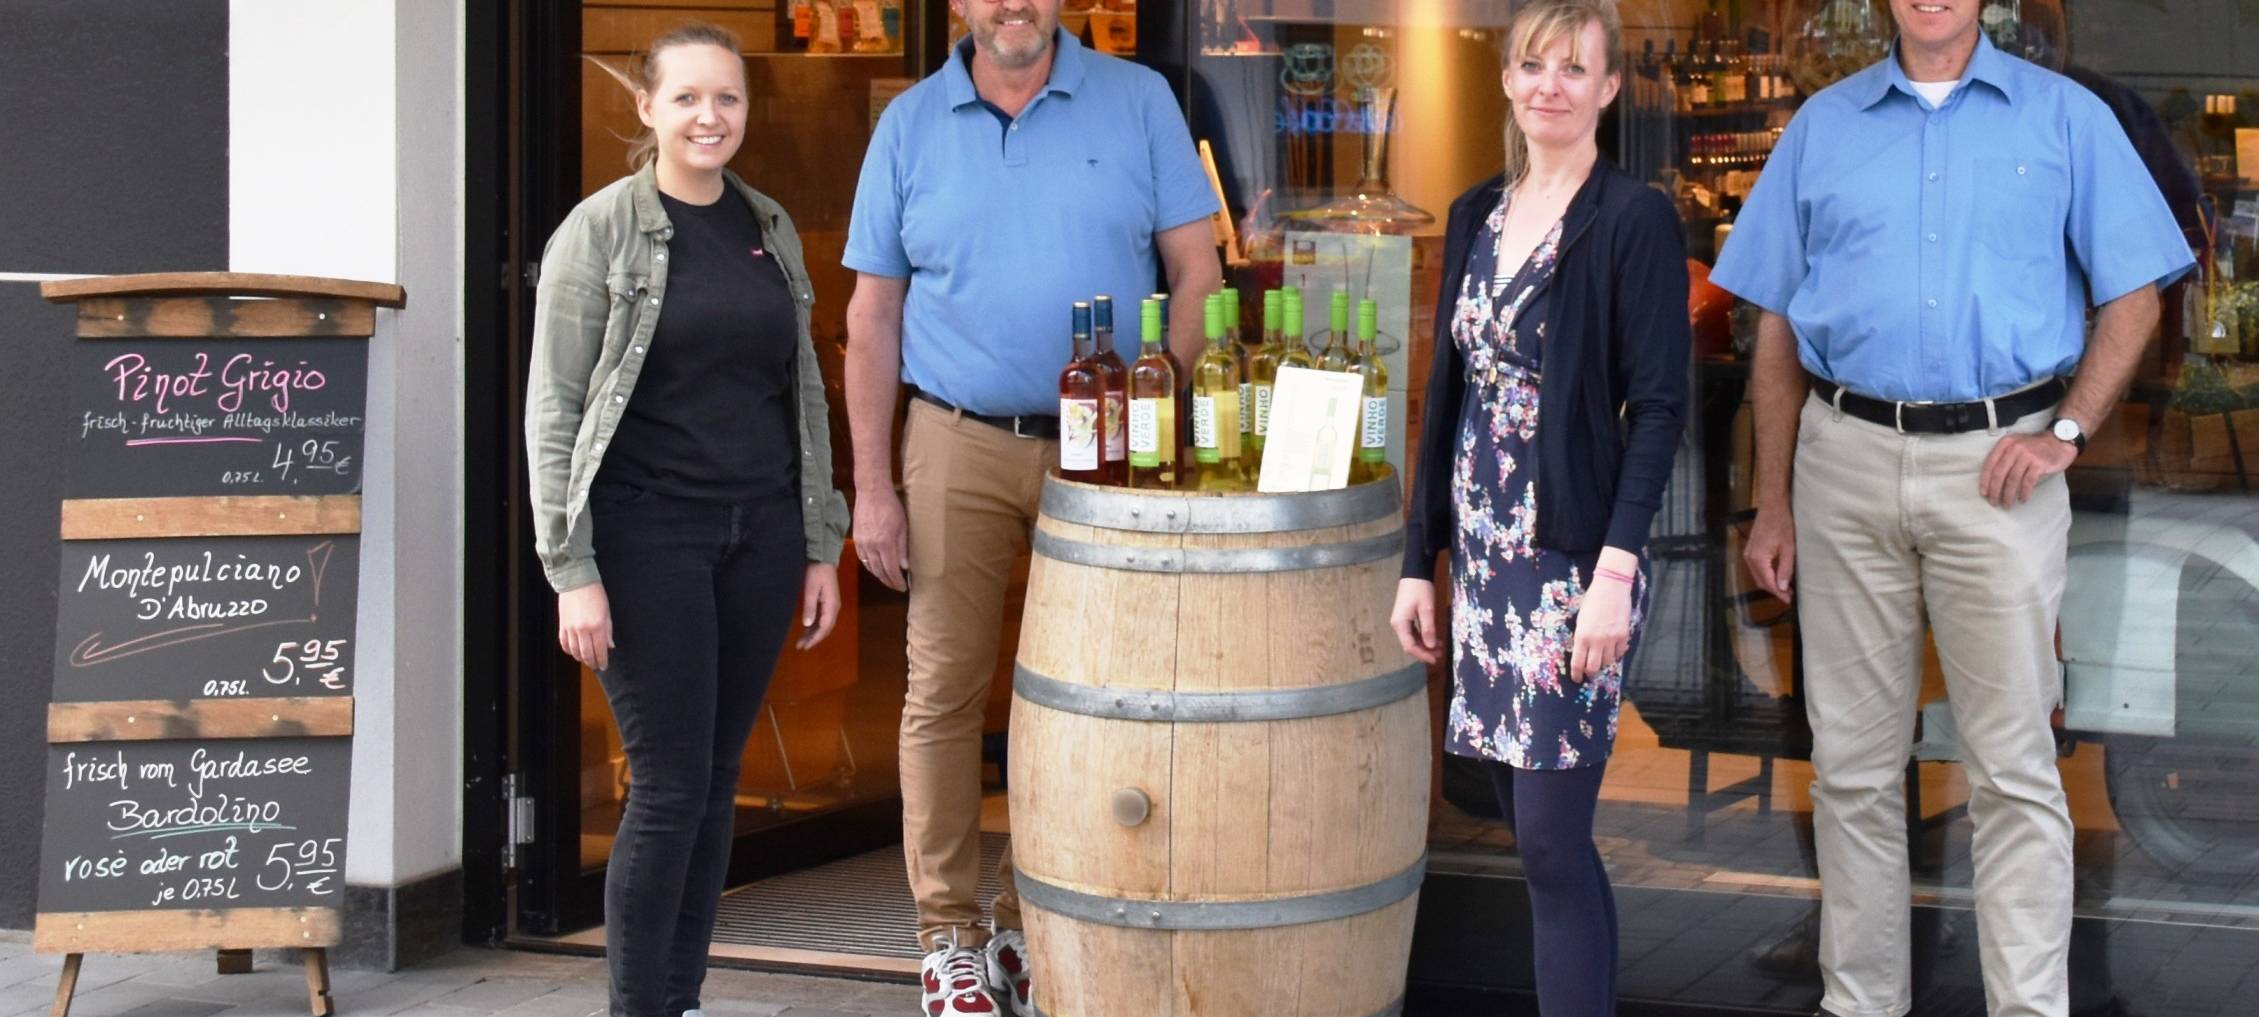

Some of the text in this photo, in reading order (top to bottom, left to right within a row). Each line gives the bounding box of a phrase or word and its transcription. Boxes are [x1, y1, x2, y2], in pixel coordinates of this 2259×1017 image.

[104, 352, 327, 414] Pinot Grigio
[223, 410, 361, 436] Alltagsklassiker
[1140, 403, 1152, 449] VERDE
[1200, 400, 1209, 444] VERDE
[1367, 400, 1378, 445] VINHO
[1377, 399, 1386, 444] VERDE
[77, 551, 301, 597] Montepulciano
[136, 595, 268, 620] D'Abruzzo
[62, 748, 312, 798] frisch vom Gardasee
[106, 793, 281, 834] Bardolino
[139, 847, 192, 875] oder
[199, 835, 240, 871] rot
[151, 883, 176, 905] je
